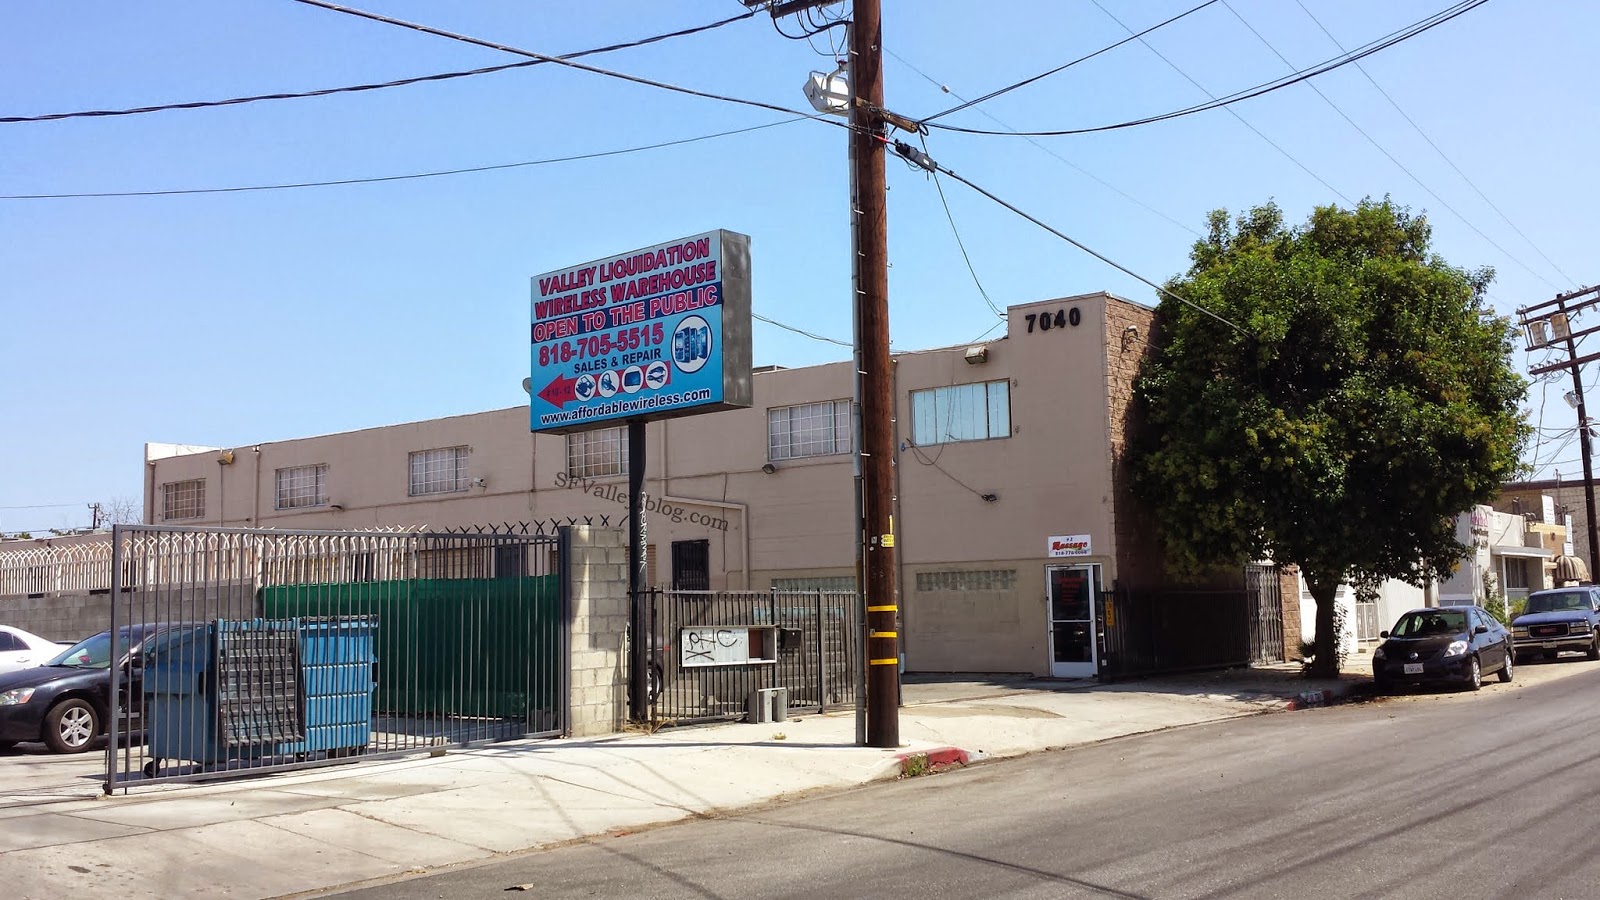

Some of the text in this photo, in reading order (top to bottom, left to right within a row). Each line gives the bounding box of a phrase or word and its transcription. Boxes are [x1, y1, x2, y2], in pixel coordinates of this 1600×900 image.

[539, 237, 710, 297] VALLEY LIQUIDATION
[534, 260, 717, 320] WIRELESS WAREHOUSE
[533, 285, 718, 342] OPEN TO THE PUBLIC
[1025, 307, 1081, 333] 7040
[539, 322, 665, 367] 818-705-5515
[573, 348, 662, 374] SALES & REPAIR
[540, 387, 710, 425] www.affordablewireless.com
